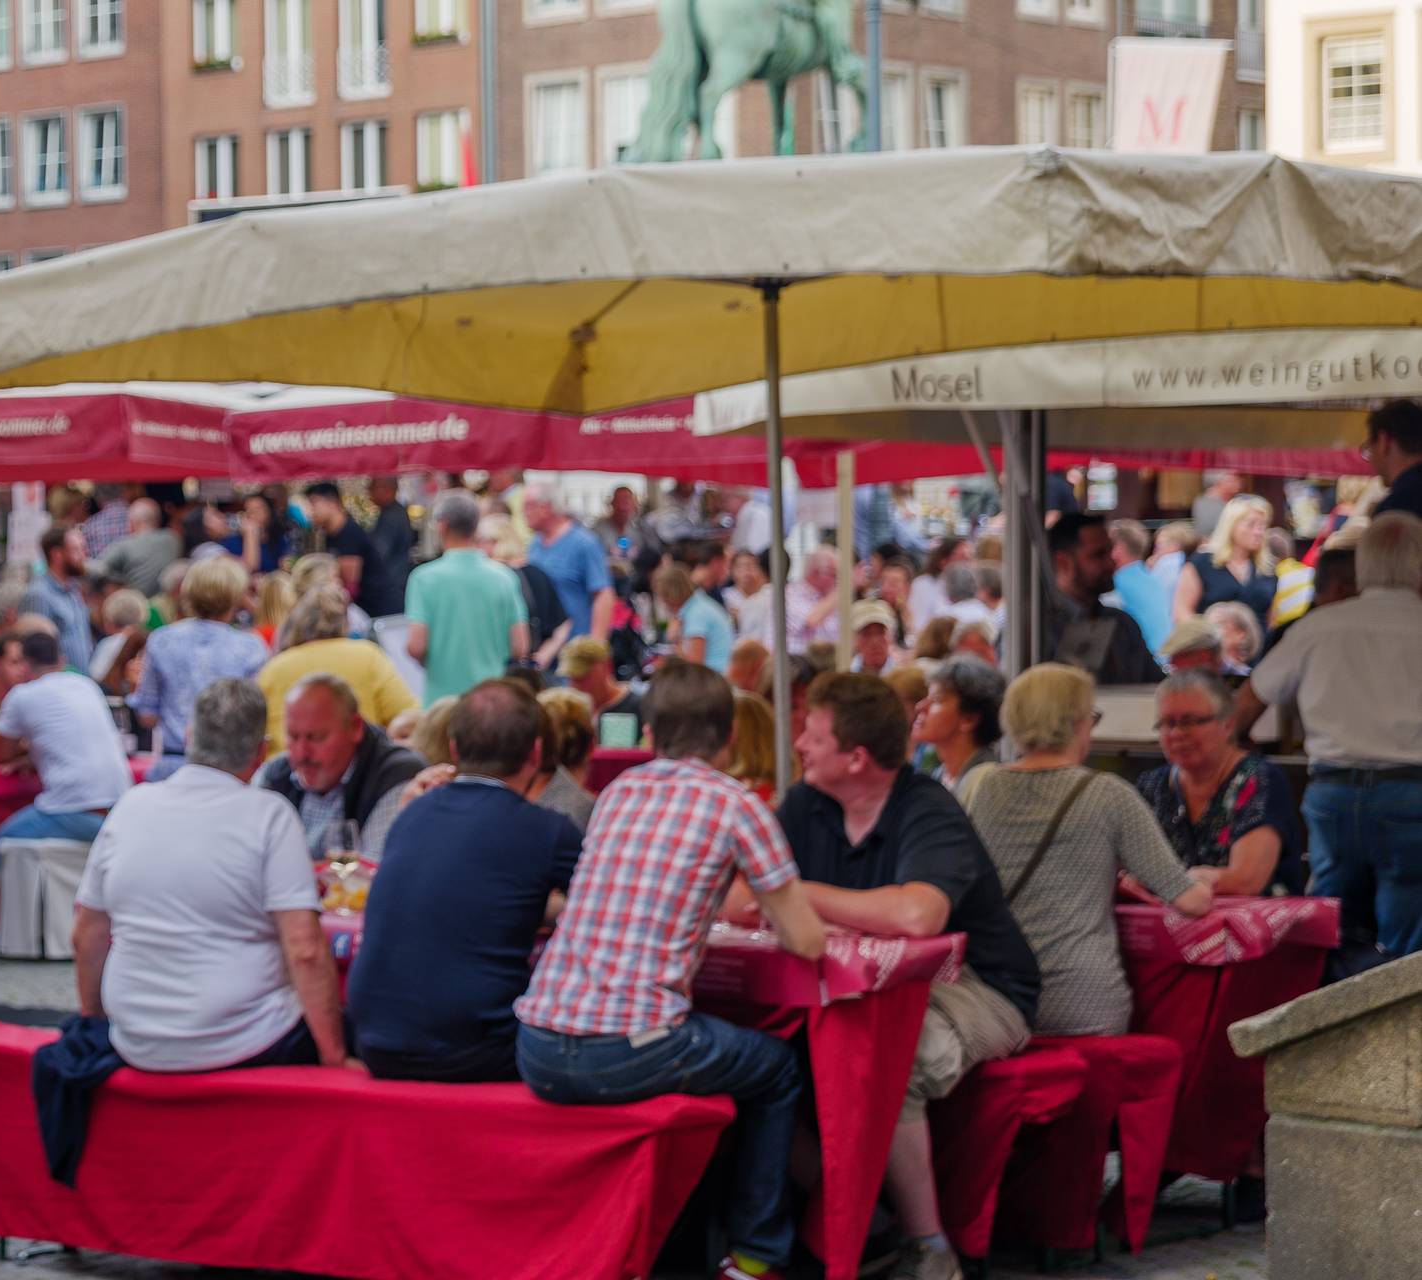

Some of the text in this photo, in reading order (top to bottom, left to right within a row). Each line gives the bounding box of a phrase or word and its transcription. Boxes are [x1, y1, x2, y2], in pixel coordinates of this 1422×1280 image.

[1138, 95, 1187, 146] M
[891, 365, 984, 402] Mosel
[1131, 352, 1422, 392] www.weingutko
[249, 412, 470, 456] www.weinsommer.de
